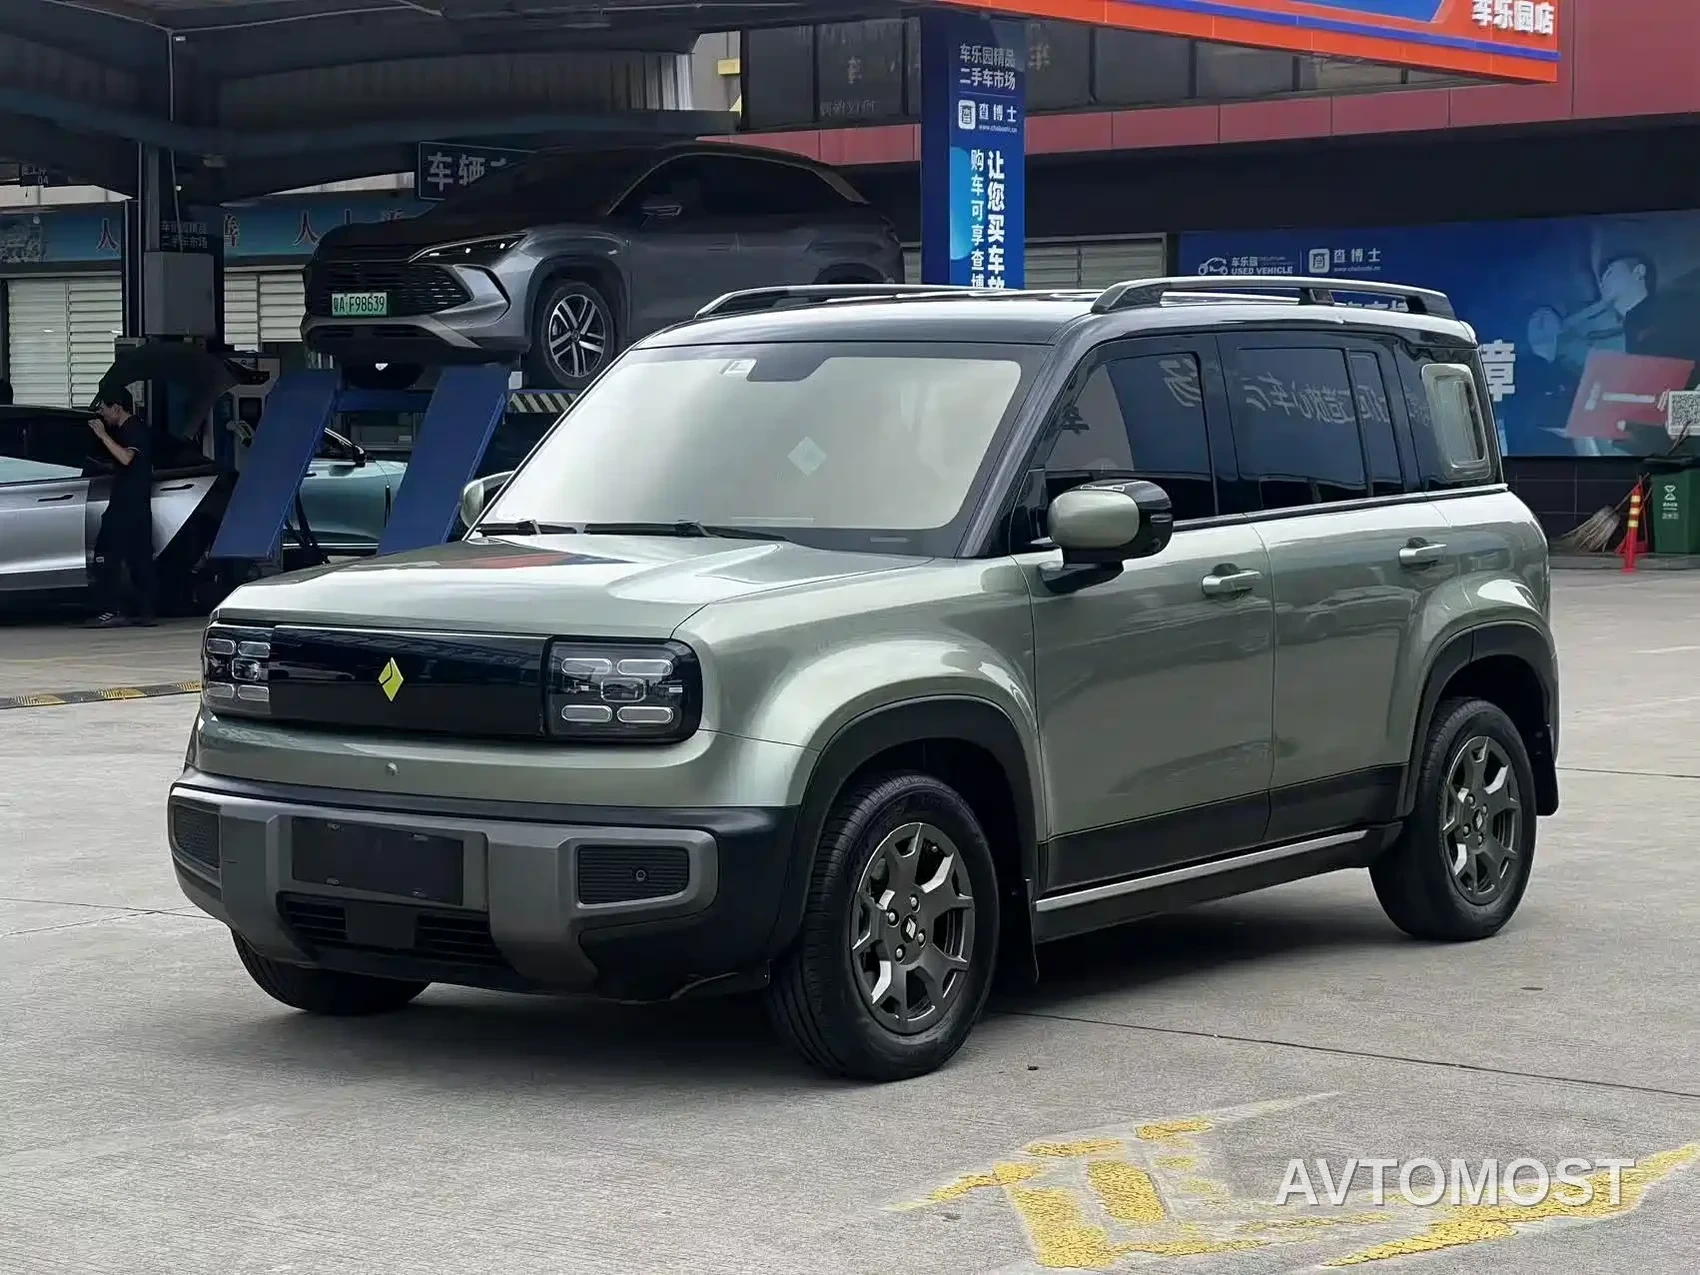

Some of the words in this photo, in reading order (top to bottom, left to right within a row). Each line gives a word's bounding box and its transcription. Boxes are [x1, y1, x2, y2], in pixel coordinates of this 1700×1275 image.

[960, 43, 1016, 68] 车乐园精品
[960, 67, 1016, 91] 二手车市场
[979, 103, 1017, 123] 查博士
[426, 151, 508, 192] 车辆
[1231, 267, 1254, 275] USED
[1256, 265, 1294, 275] VEHICLE
